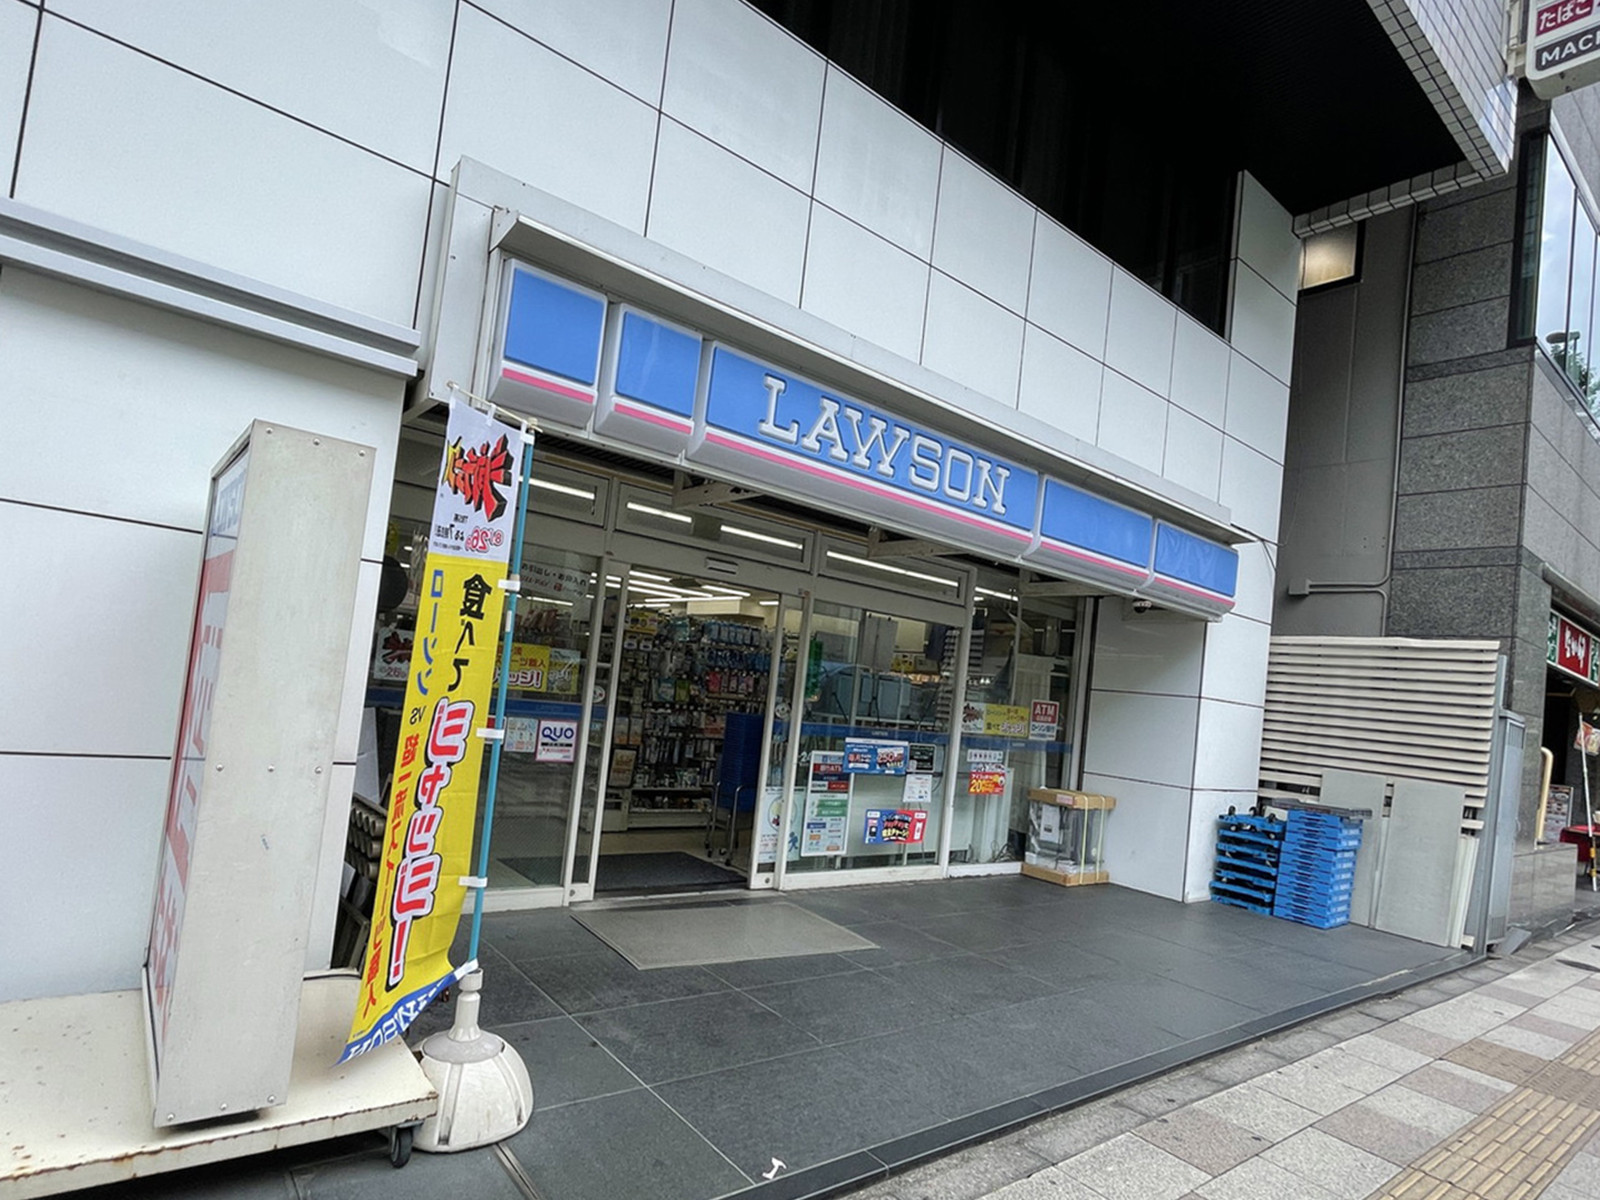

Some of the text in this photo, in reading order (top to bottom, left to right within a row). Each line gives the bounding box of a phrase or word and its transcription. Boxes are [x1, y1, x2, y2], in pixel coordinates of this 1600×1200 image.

[1539, 0, 1592, 31] たばこ
[758, 374, 1011, 516] LAWSON
[1034, 703, 1056, 716] ATM
[541, 726, 575, 742] QUO
